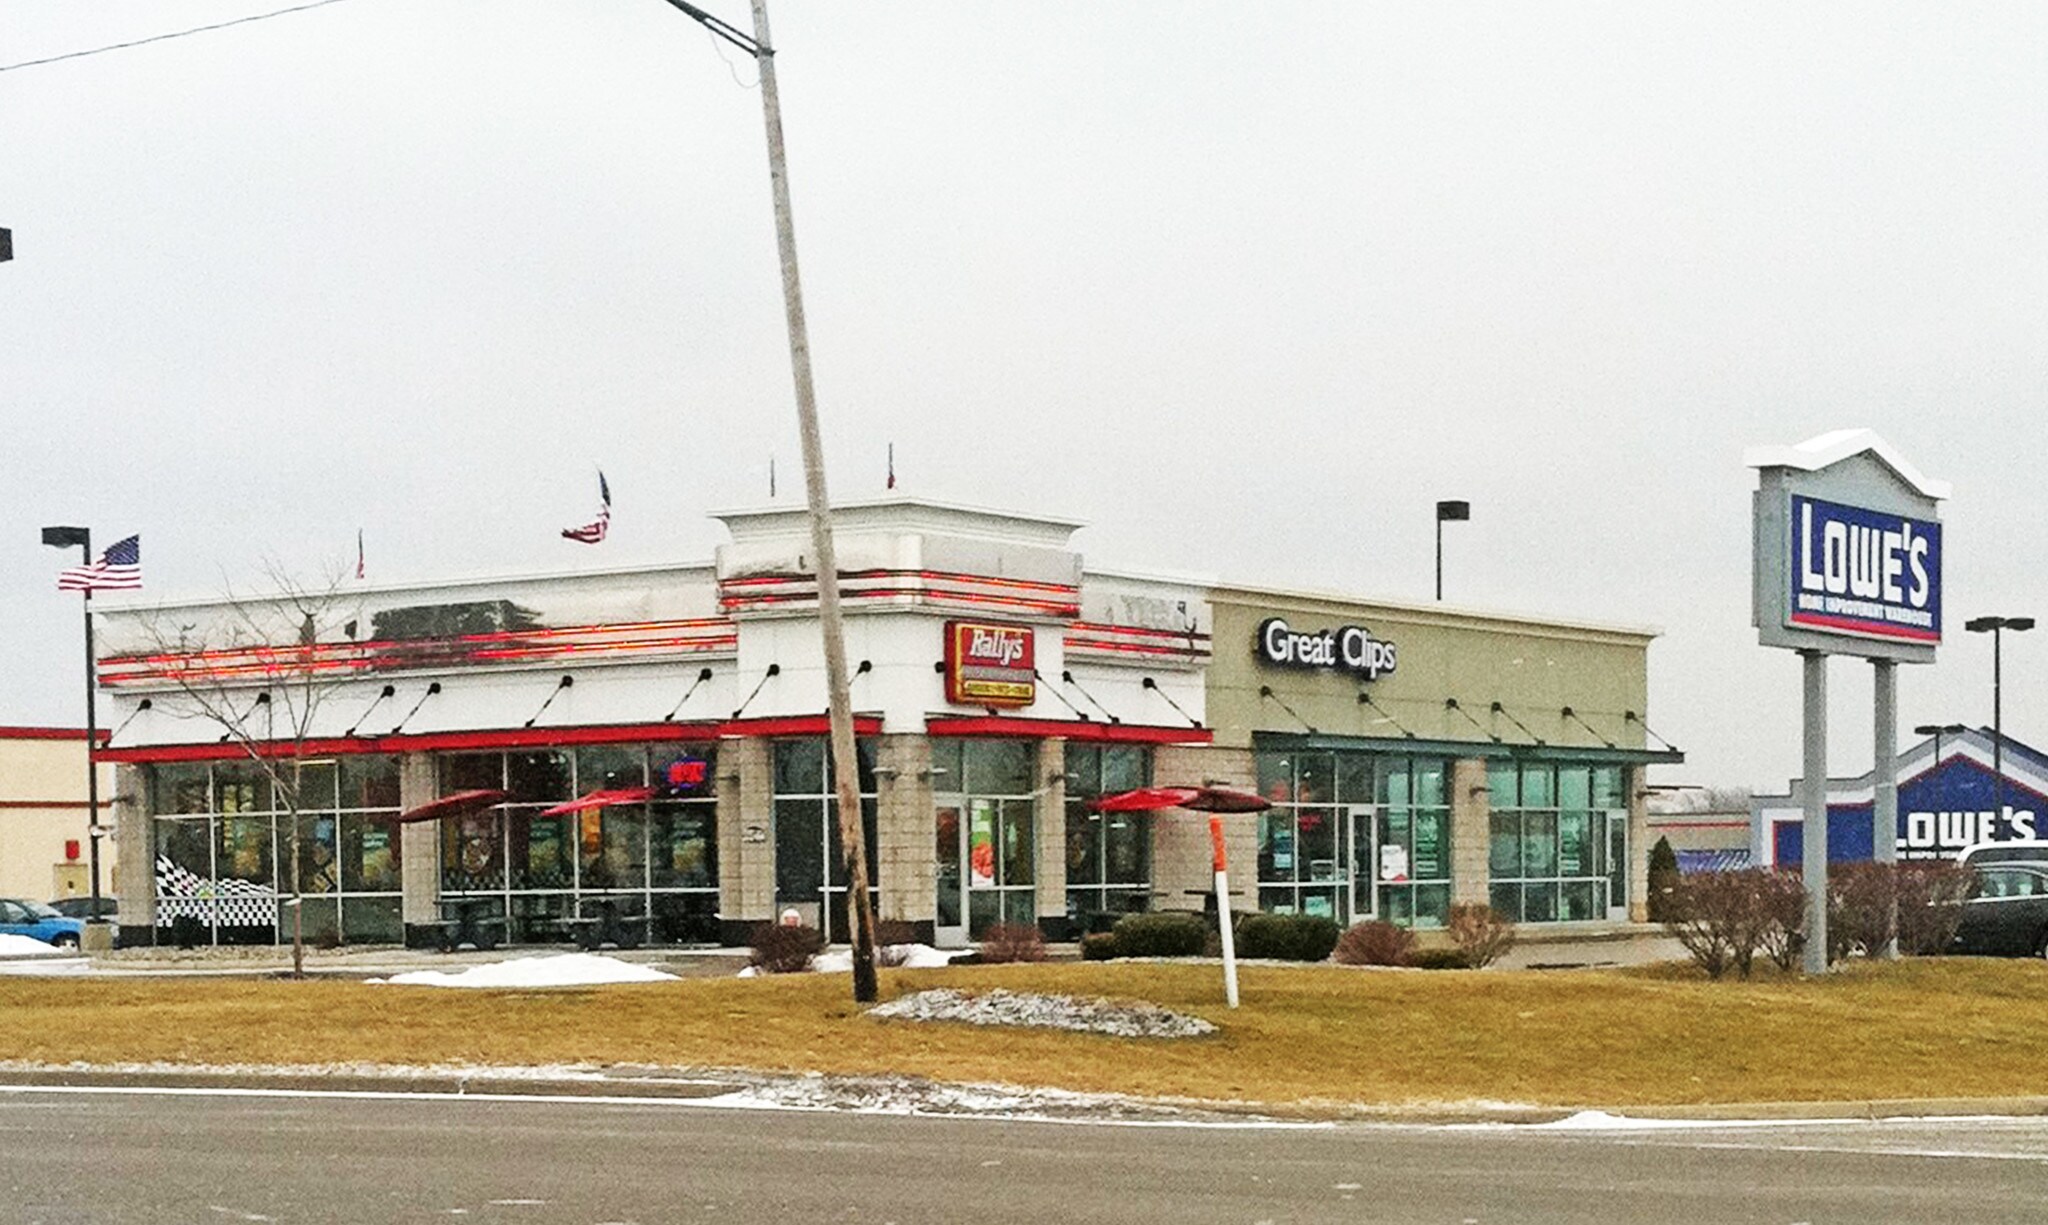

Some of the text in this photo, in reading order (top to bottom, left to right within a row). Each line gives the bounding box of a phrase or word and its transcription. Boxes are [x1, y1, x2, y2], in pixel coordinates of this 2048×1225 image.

[1801, 502, 1929, 608] LOWE'S
[1265, 619, 1396, 679] Great Clips
